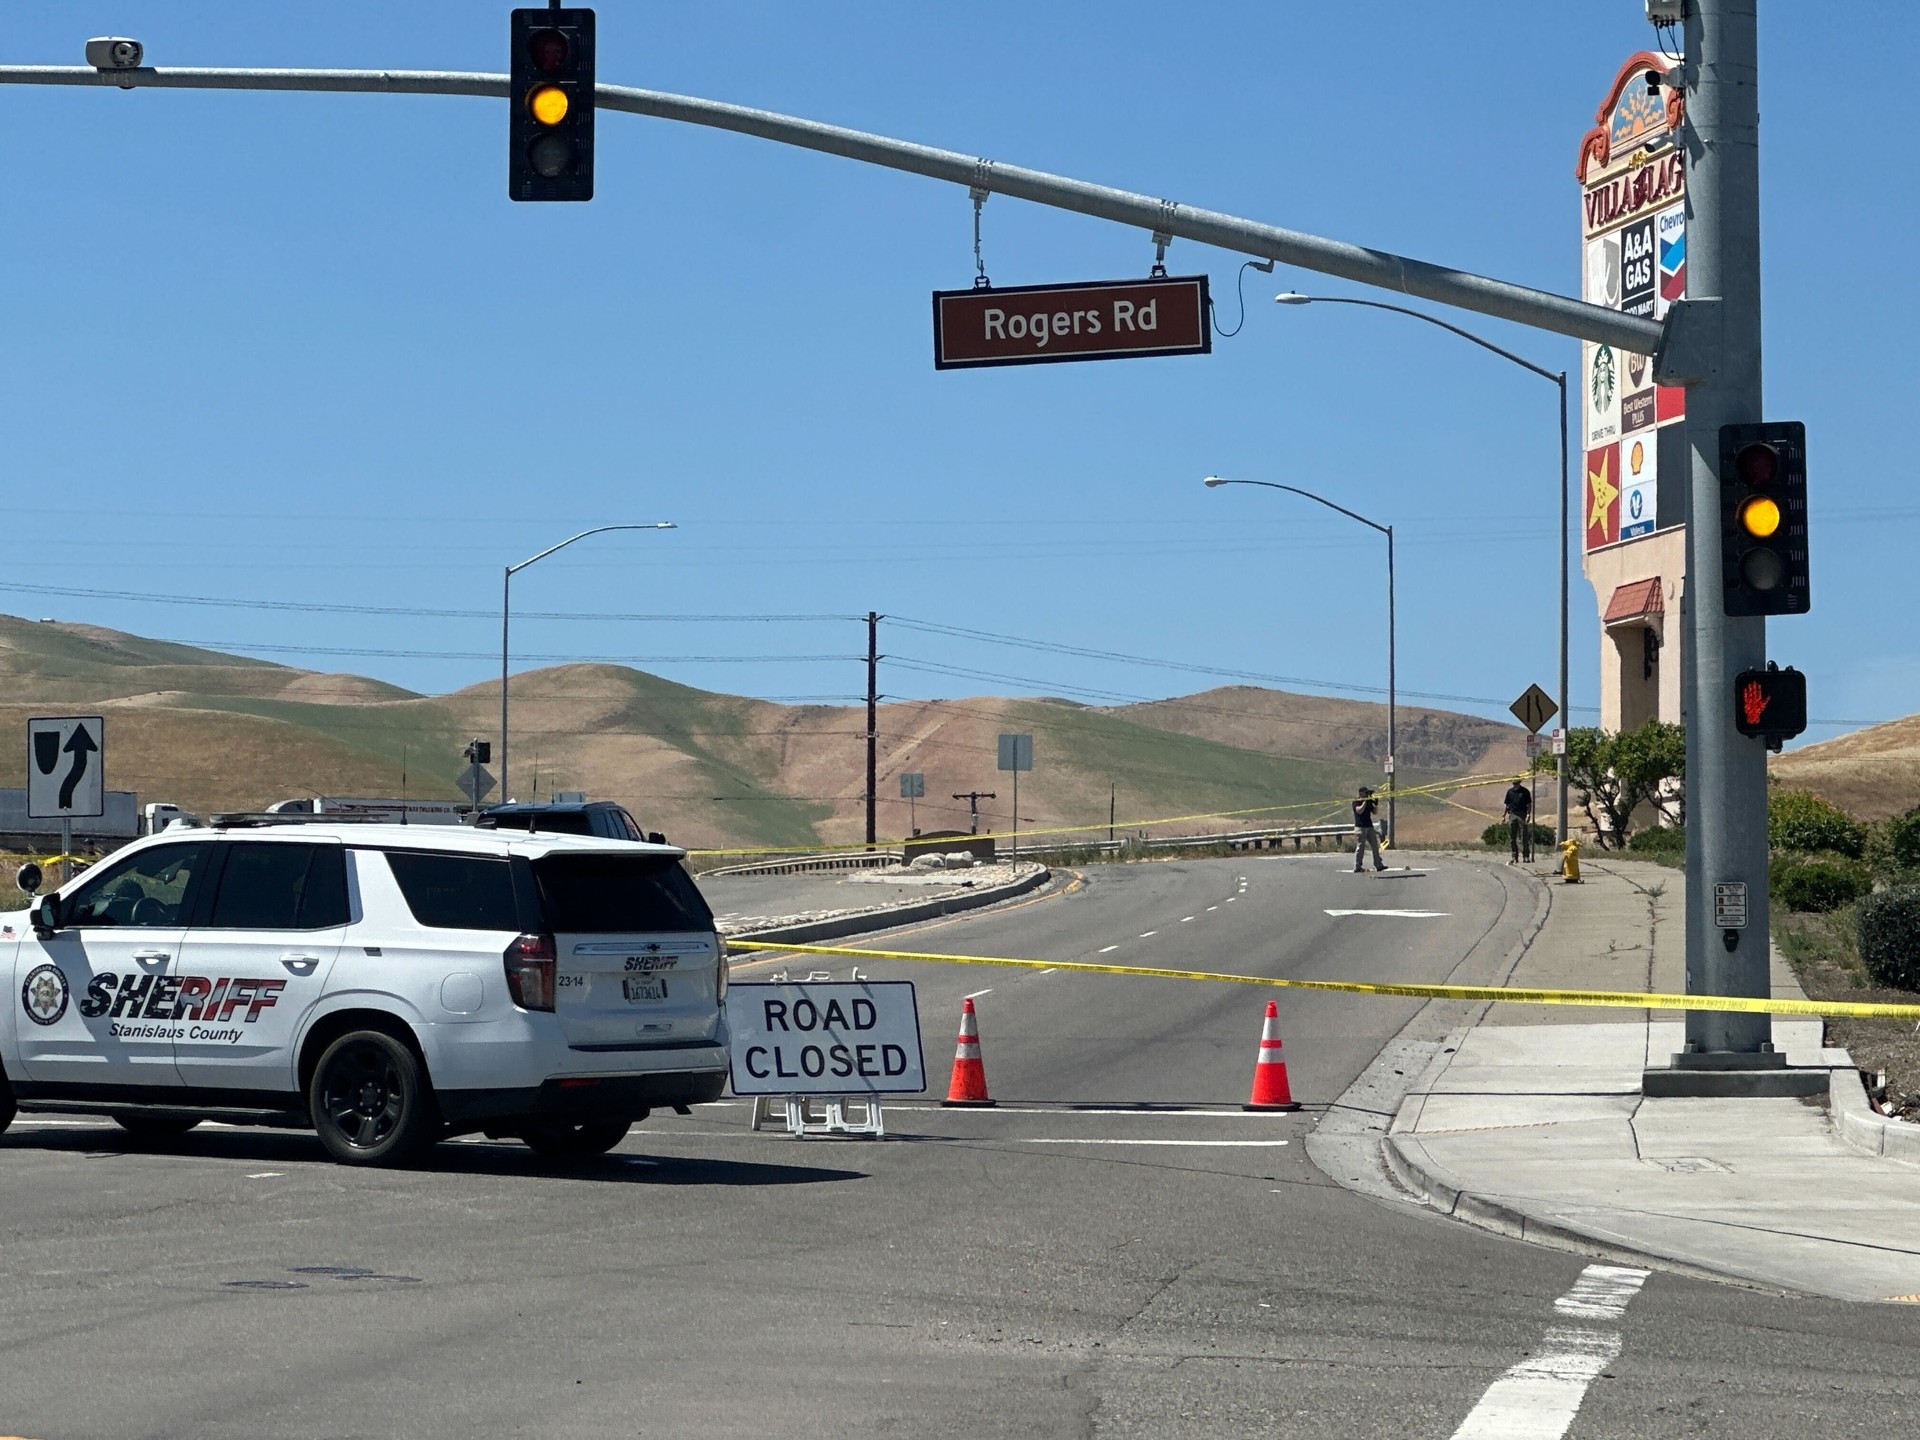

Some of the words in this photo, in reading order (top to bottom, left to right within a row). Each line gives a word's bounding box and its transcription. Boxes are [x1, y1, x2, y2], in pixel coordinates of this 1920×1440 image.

[1584, 176, 1634, 229] VILLA
[1646, 150, 1684, 205] LAG
[1660, 212, 1684, 232] Chevro
[1624, 225, 1652, 264] A&A
[1626, 258, 1650, 290] GAS
[1638, 300, 1654, 316] MART
[984, 308, 1102, 347] Rogers
[1114, 298, 1156, 332] Rd
[1624, 402, 1633, 415] Best
[1634, 396, 1652, 410] Western
[1632, 410, 1644, 425] PLUS
[624, 956, 678, 971] SHERIFF
[558, 976, 583, 987] 23-14
[80, 972, 287, 1022] SHERIFF
[764, 999, 876, 1032] ROAD
[109, 1023, 184, 1039] Stanislaus
[189, 1026, 243, 1044] County
[746, 1044, 906, 1078] CLOSED
